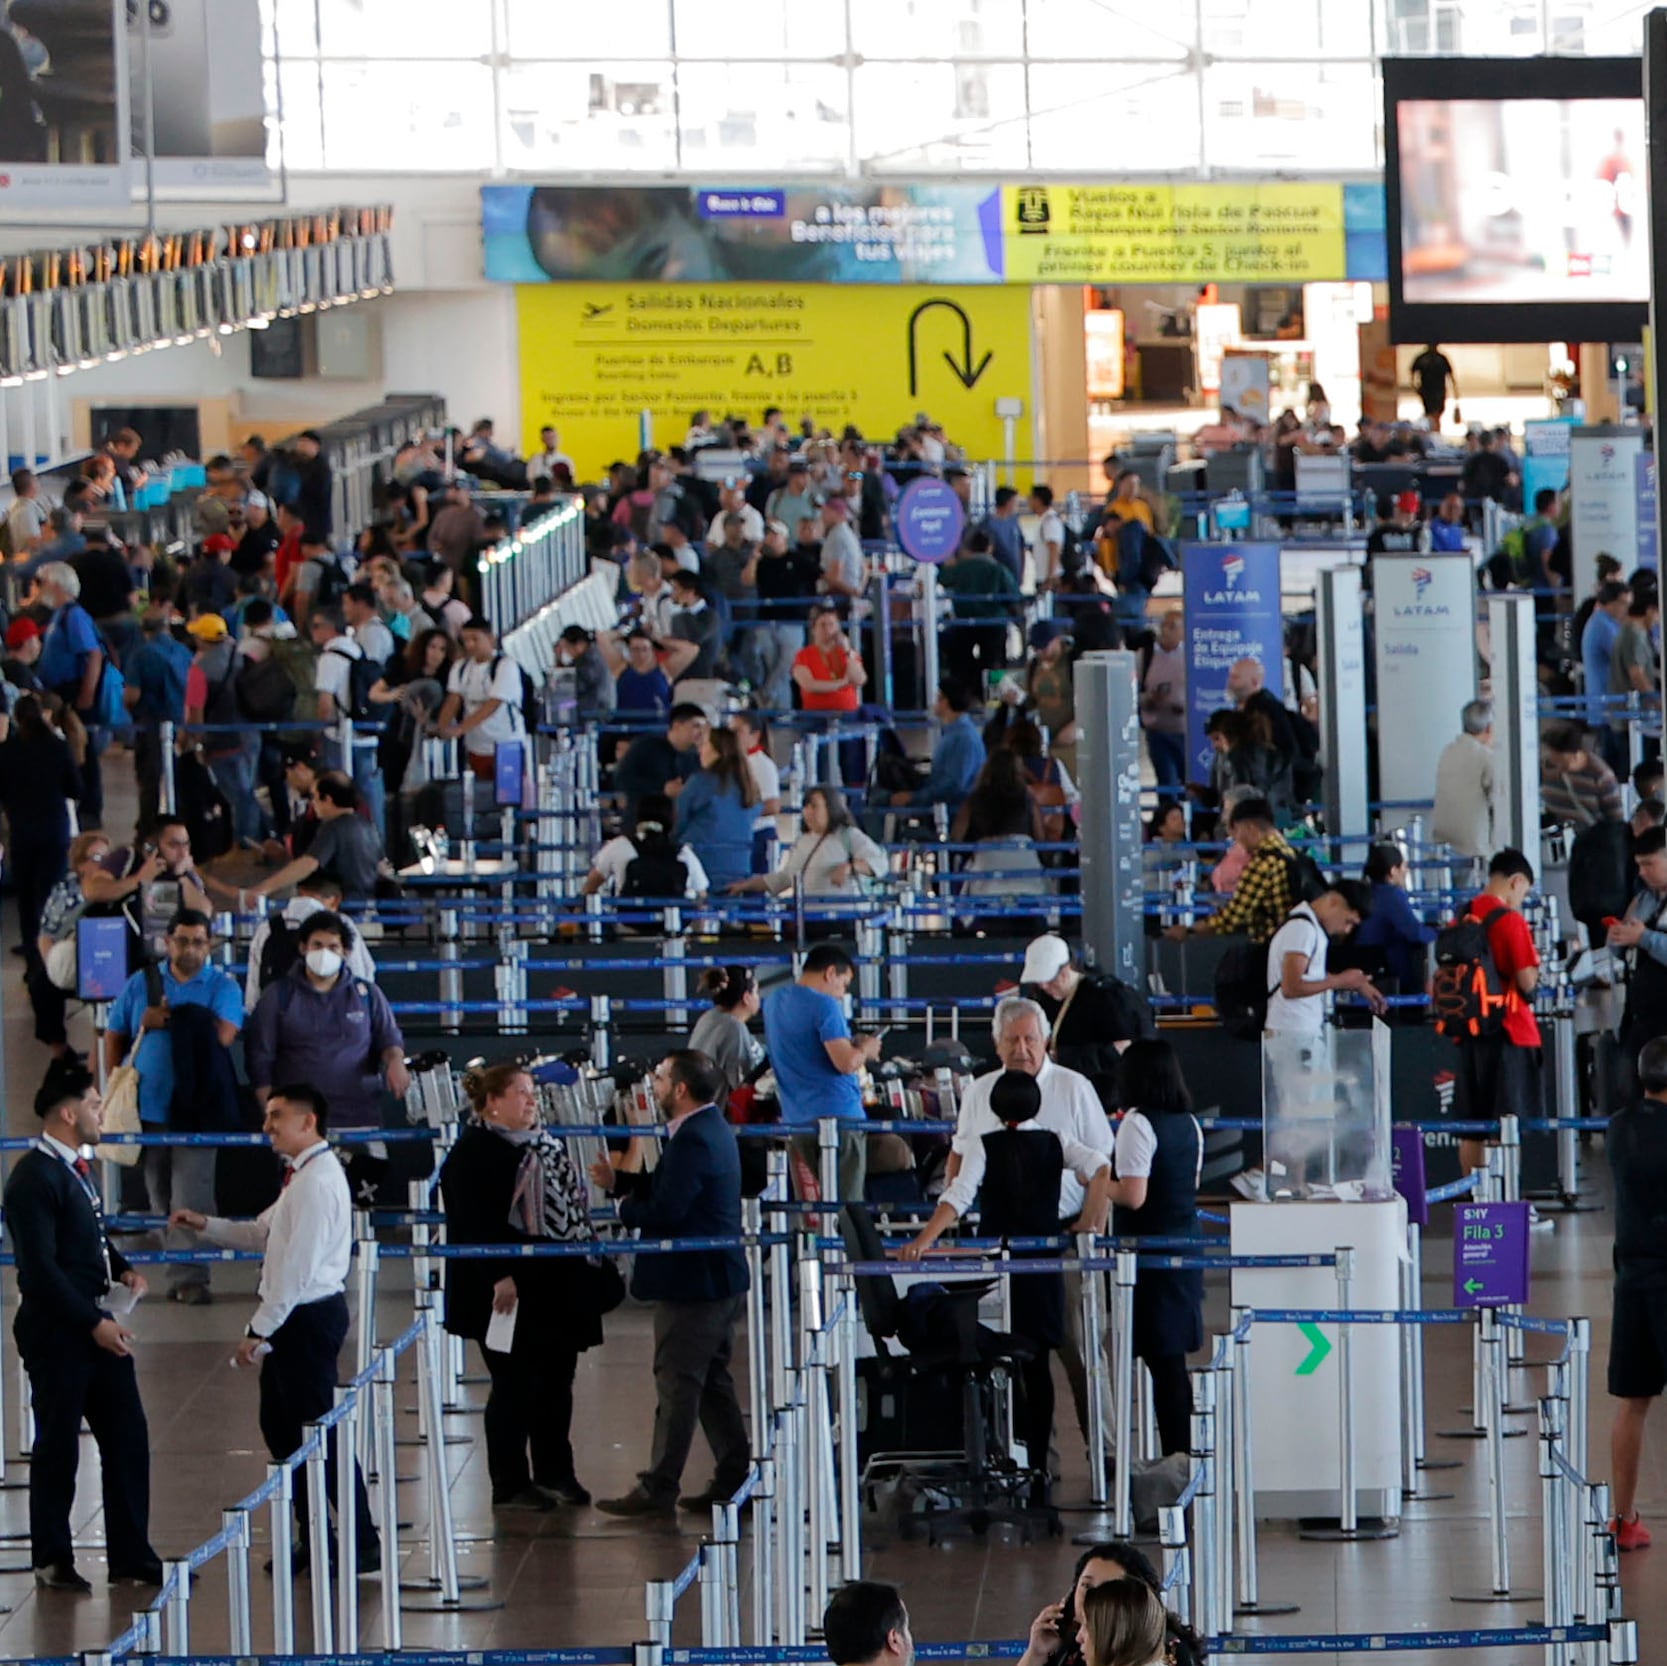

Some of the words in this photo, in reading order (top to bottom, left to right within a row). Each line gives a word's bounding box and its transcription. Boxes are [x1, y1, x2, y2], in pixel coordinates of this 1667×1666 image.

[1069, 188, 1137, 202] Vuelos
[1217, 204, 1243, 218] de
[855, 242, 891, 261] tus
[1131, 243, 1196, 257] Puerta
[626, 292, 693, 310] Salidas
[699, 292, 805, 310] Nacionales
[626, 318, 702, 332] Domestic
[708, 317, 801, 334] Departures
[1203, 590, 1261, 605] LATAM
[1394, 605, 1450, 616] LATAM
[1193, 628, 1241, 642] Entrega
[1384, 643, 1419, 655] Salida
[1464, 1224, 1491, 1241] Fila
[1494, 1224, 1504, 1240] 3
